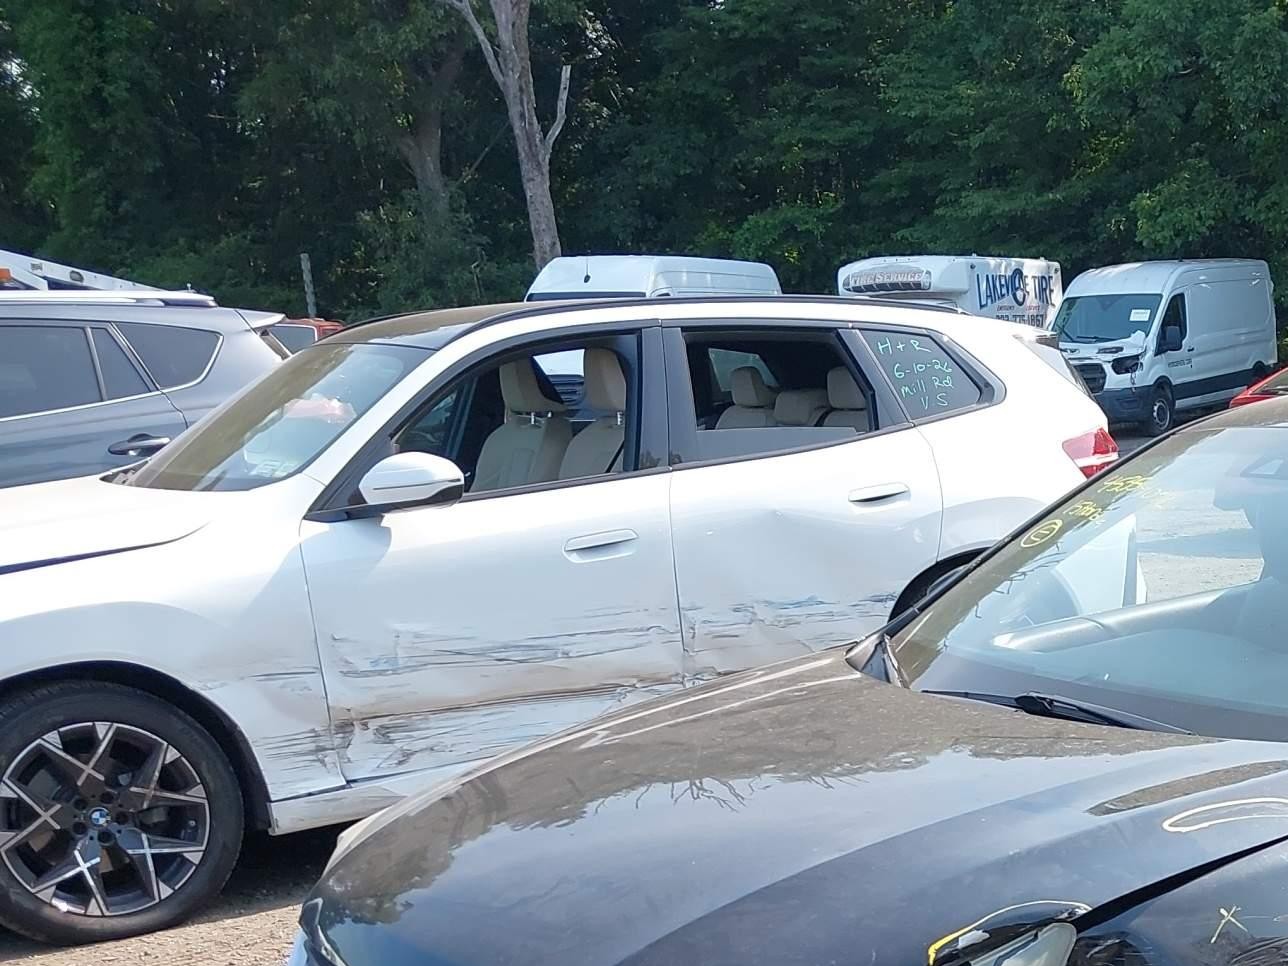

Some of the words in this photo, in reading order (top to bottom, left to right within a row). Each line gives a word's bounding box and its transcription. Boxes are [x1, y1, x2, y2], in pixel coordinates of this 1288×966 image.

[1031, 275, 1056, 307] TIRE
[878, 337, 893, 355] H
[910, 339, 932, 353] R
